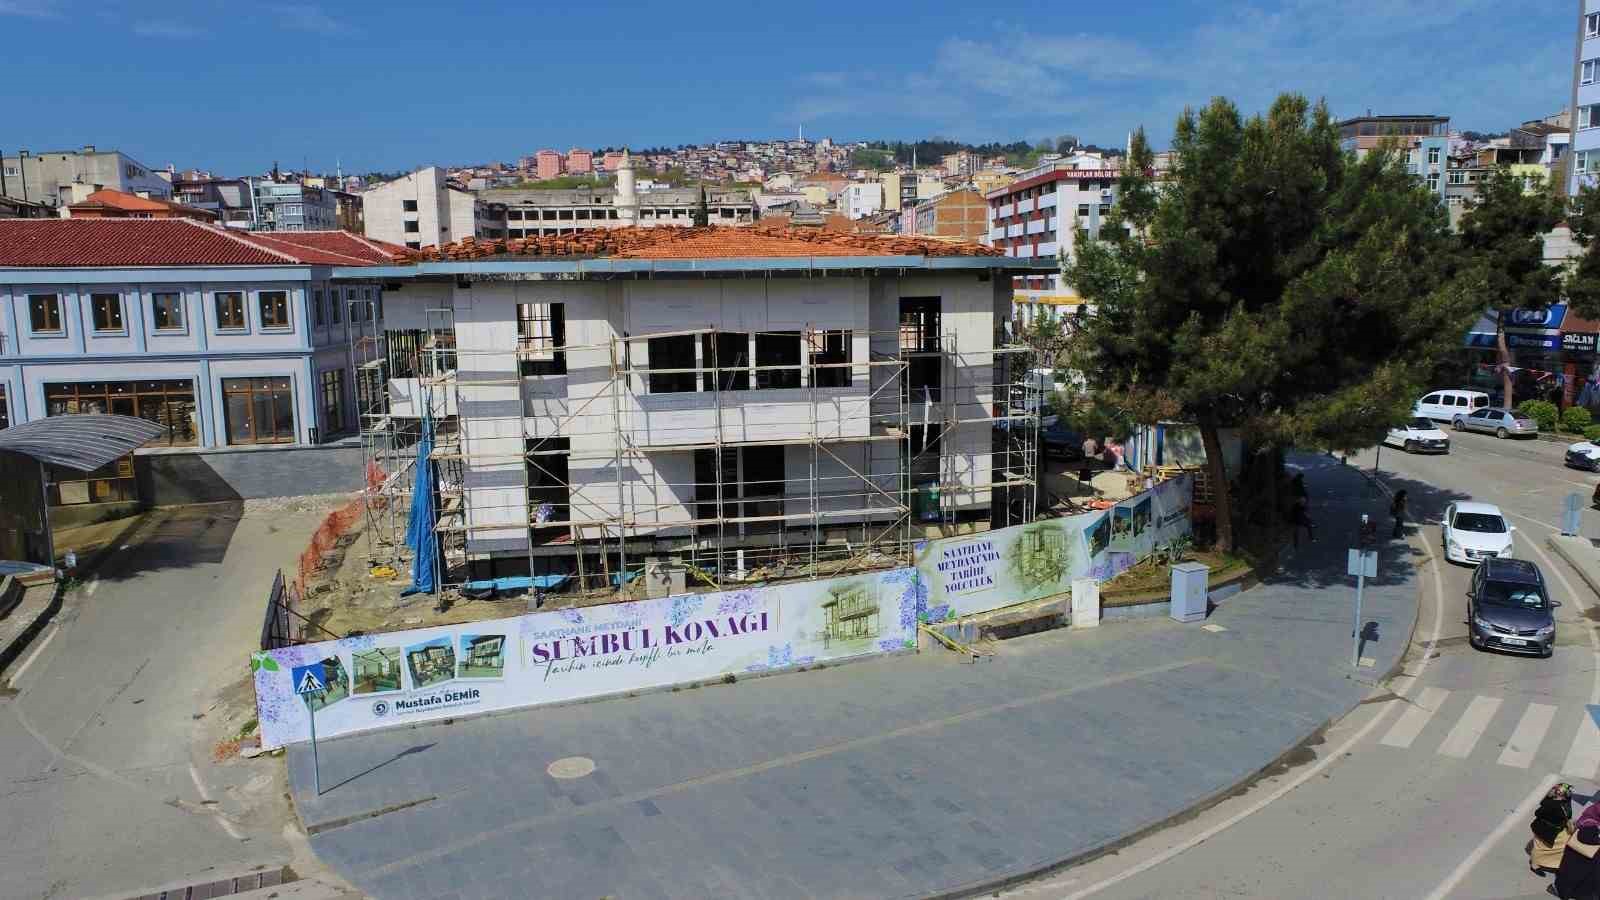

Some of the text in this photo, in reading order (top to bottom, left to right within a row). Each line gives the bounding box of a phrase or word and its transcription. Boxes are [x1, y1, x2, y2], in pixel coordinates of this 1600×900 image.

[1066, 170, 1093, 178] VAKIFLAR
[943, 541, 991, 559] SAATHANE
[945, 576, 993, 593] YOLCULUK
[533, 611, 768, 664] SÜMBÜL KONAĞI
[395, 695, 442, 711] Mustafa
[444, 688, 480, 703] DEMİR
